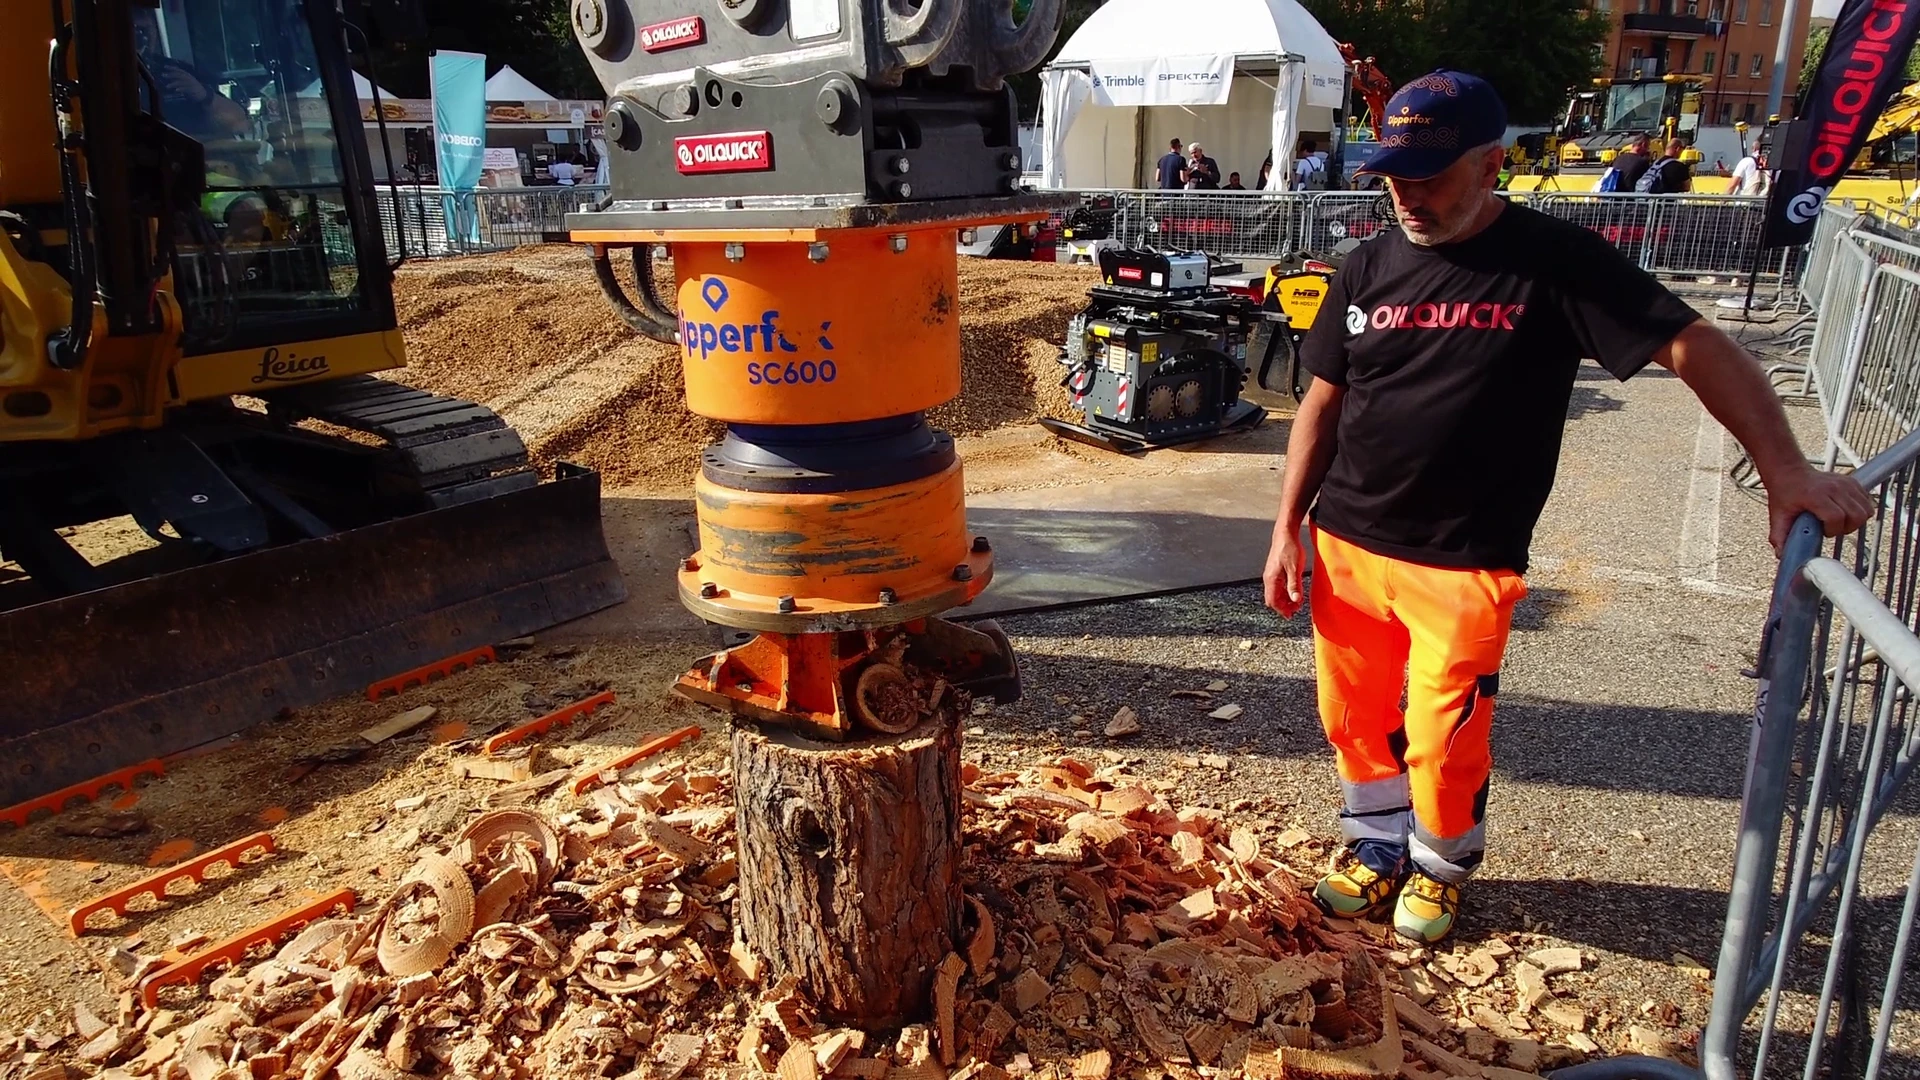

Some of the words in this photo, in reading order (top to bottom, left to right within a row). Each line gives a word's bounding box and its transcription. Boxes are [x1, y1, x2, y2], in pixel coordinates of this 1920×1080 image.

[1104, 75, 1145, 87] Trimble
[1158, 72, 1220, 81] SPEKTRA
[693, 140, 761, 163] OILQUICK
[251, 347, 331, 384] Leica
[747, 359, 837, 385] SC600
